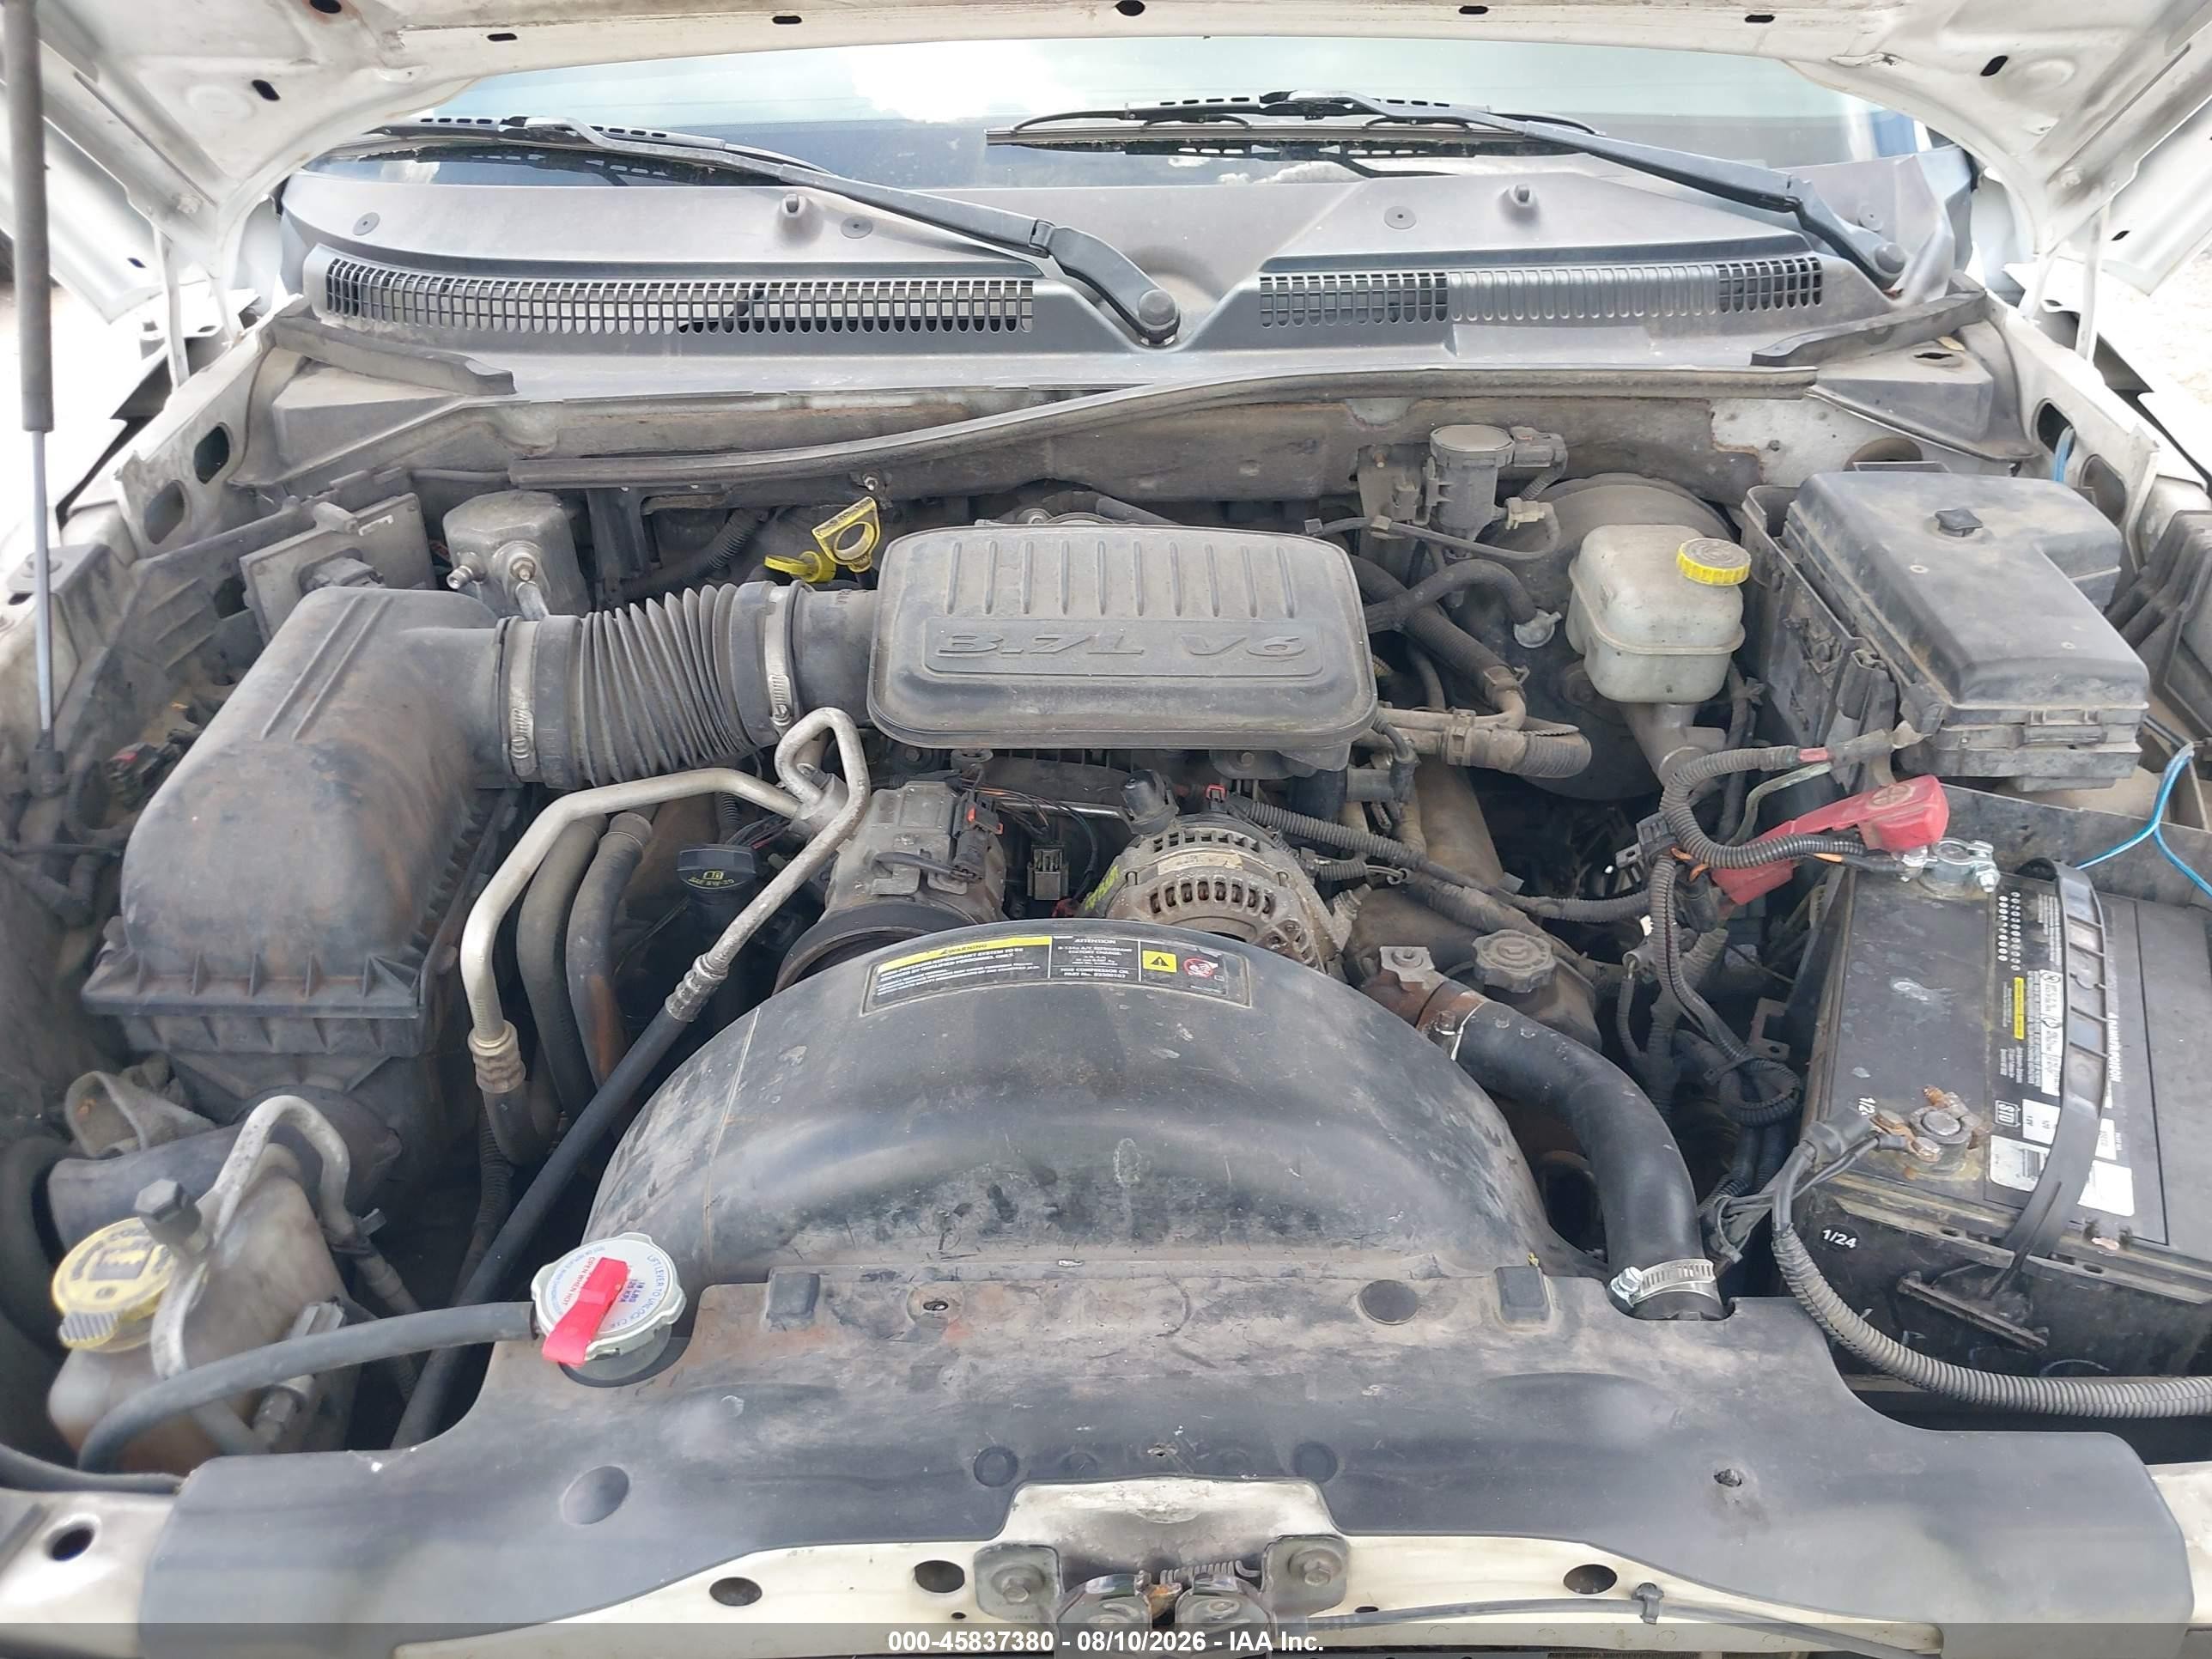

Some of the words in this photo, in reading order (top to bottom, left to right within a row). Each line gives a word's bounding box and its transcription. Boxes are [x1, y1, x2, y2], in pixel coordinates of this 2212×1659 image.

[936, 632, 1145, 658] 3.7L
[1181, 634, 1307, 657] V6
[948, 944, 988, 953] WARNING
[1857, 1097, 1876, 1115] 1/2
[1998, 1103, 2016, 1123] STD
[1822, 1229, 1858, 1249] 1/24
[580, 1256, 596, 1275] OPEN
[568, 1275, 586, 1294] WHEN
[653, 1266, 665, 1288] LEVER
